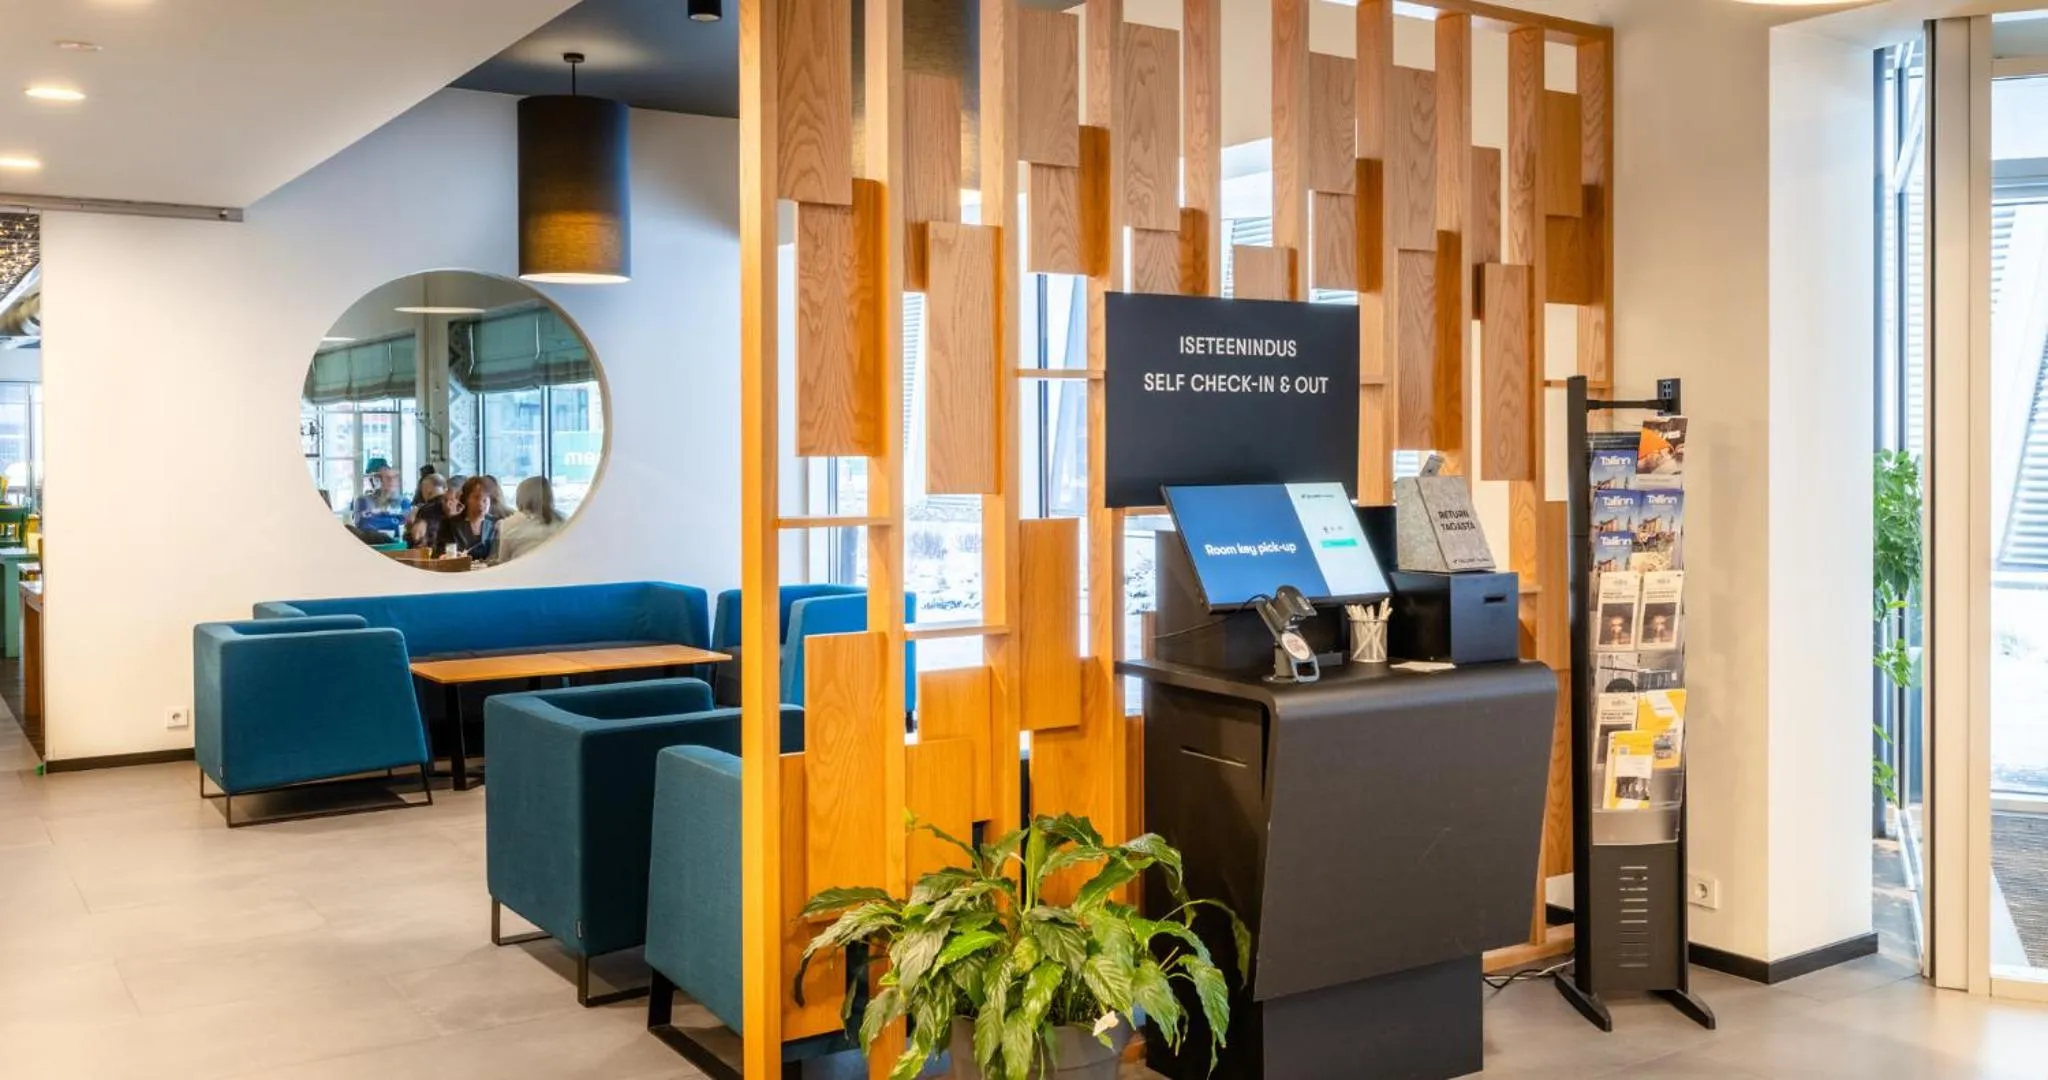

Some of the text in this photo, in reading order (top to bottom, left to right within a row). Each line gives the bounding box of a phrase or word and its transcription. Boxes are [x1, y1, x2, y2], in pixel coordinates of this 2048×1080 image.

[1179, 335, 1298, 357] ISETEENINDUS
[1143, 372, 1330, 394] SELF CHECK-IN & OUT
[1601, 456, 1631, 466] Tallinn
[1603, 496, 1634, 506] Tallinn
[1647, 495, 1677, 504] Tallinn
[1437, 510, 1470, 519] RETURN
[1601, 536, 1632, 546] Tallinn
[1204, 541, 1297, 557] Room key pick-up
